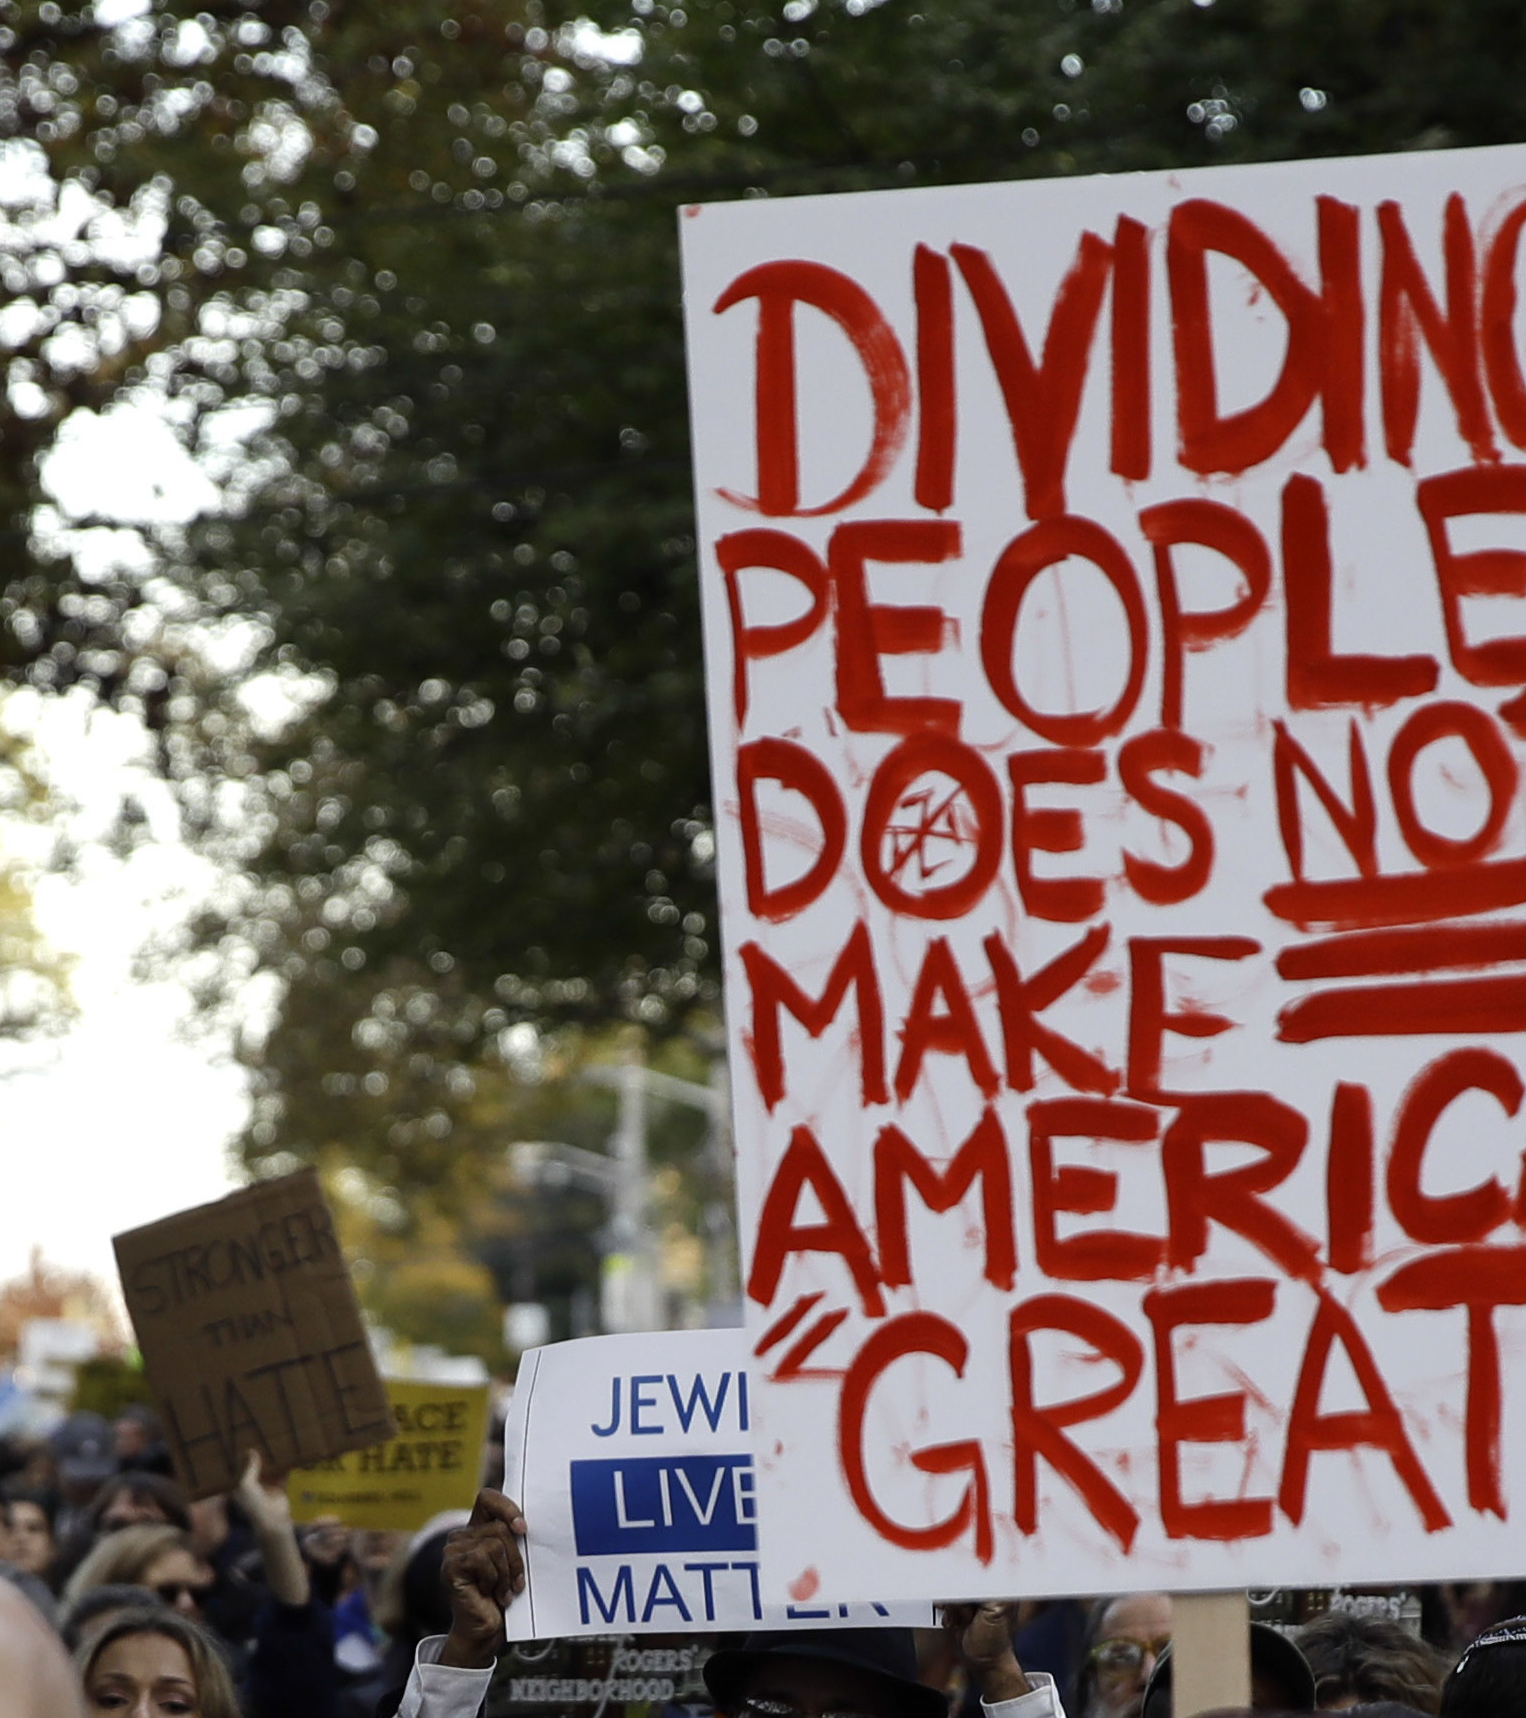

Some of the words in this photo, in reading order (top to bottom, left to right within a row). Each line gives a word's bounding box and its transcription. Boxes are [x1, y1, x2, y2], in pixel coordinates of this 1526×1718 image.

[735, 730, 1216, 922] DOES
[739, 922, 1261, 1109] MAKE
[131, 1211, 337, 1315] STRONGER
[167, 1341, 389, 1489] HATE
[357, 1440, 463, 1474] HATE
[509, 1678, 675, 1701] NEIGHBORHOOD
